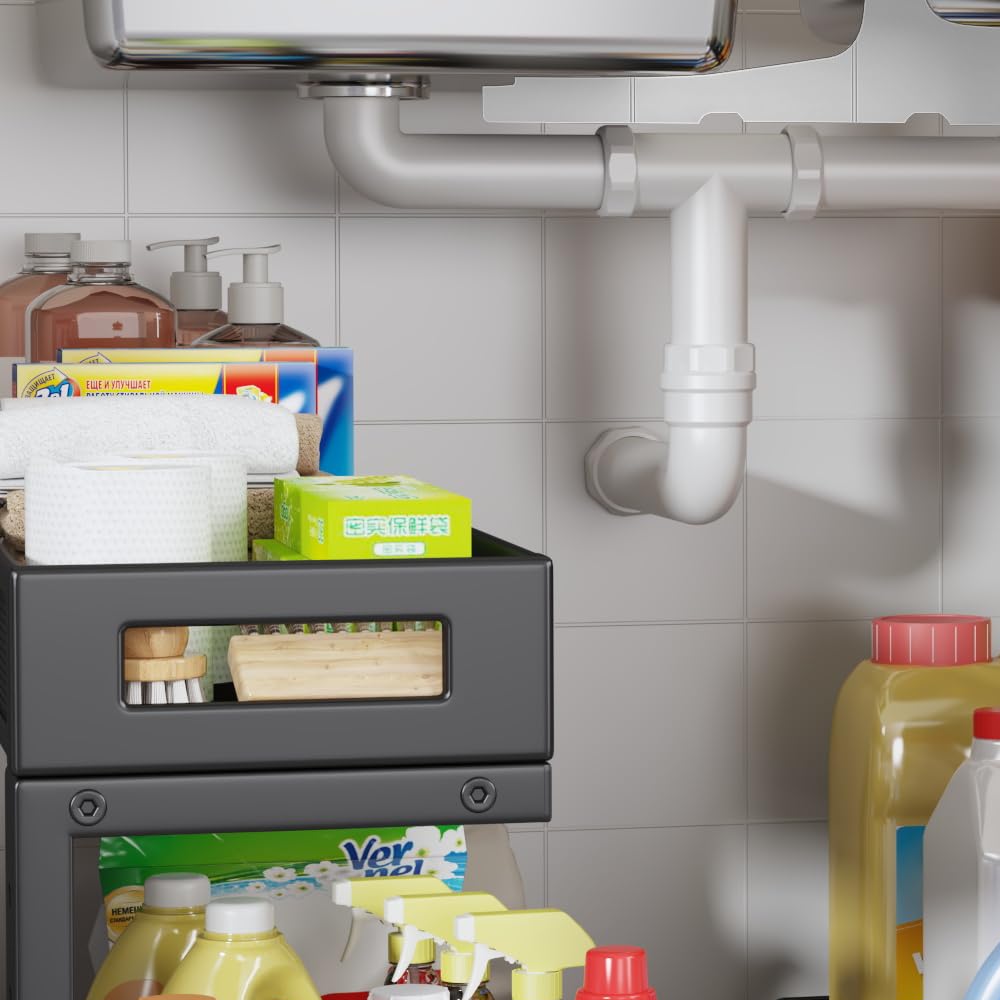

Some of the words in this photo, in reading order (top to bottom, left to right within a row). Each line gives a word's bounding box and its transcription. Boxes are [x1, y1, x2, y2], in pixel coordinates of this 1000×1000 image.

[86, 380, 103, 390] ЕЩЕ
[104, 380, 110, 389] И
[111, 380, 151, 390] УЛУЧШАЕТ
[343, 838, 414, 870] Ver
